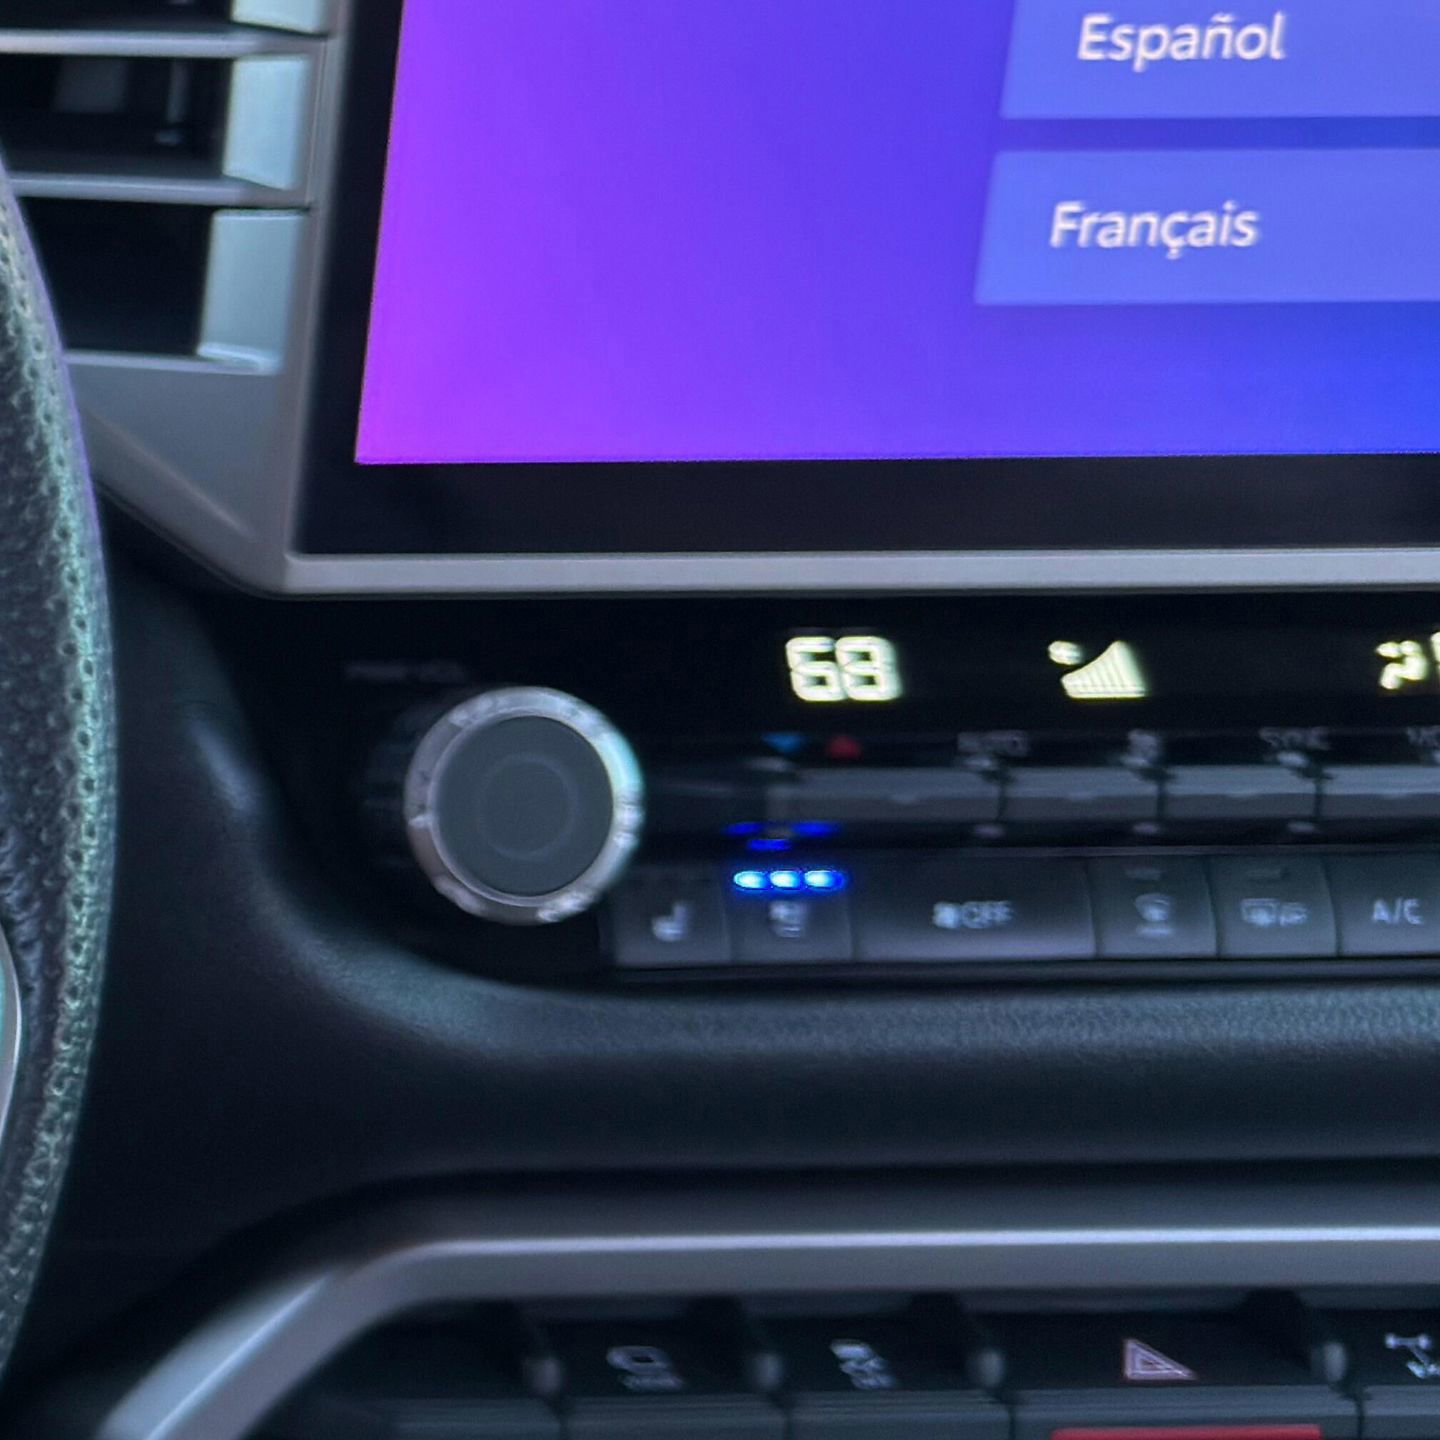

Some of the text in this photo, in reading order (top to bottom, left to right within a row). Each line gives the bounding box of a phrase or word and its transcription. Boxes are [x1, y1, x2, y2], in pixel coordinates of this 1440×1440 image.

[1077, 10, 1288, 73] Español
[1049, 200, 1259, 260] Français
[785, 636, 904, 702] 68
[1372, 897, 1424, 926] A/C
